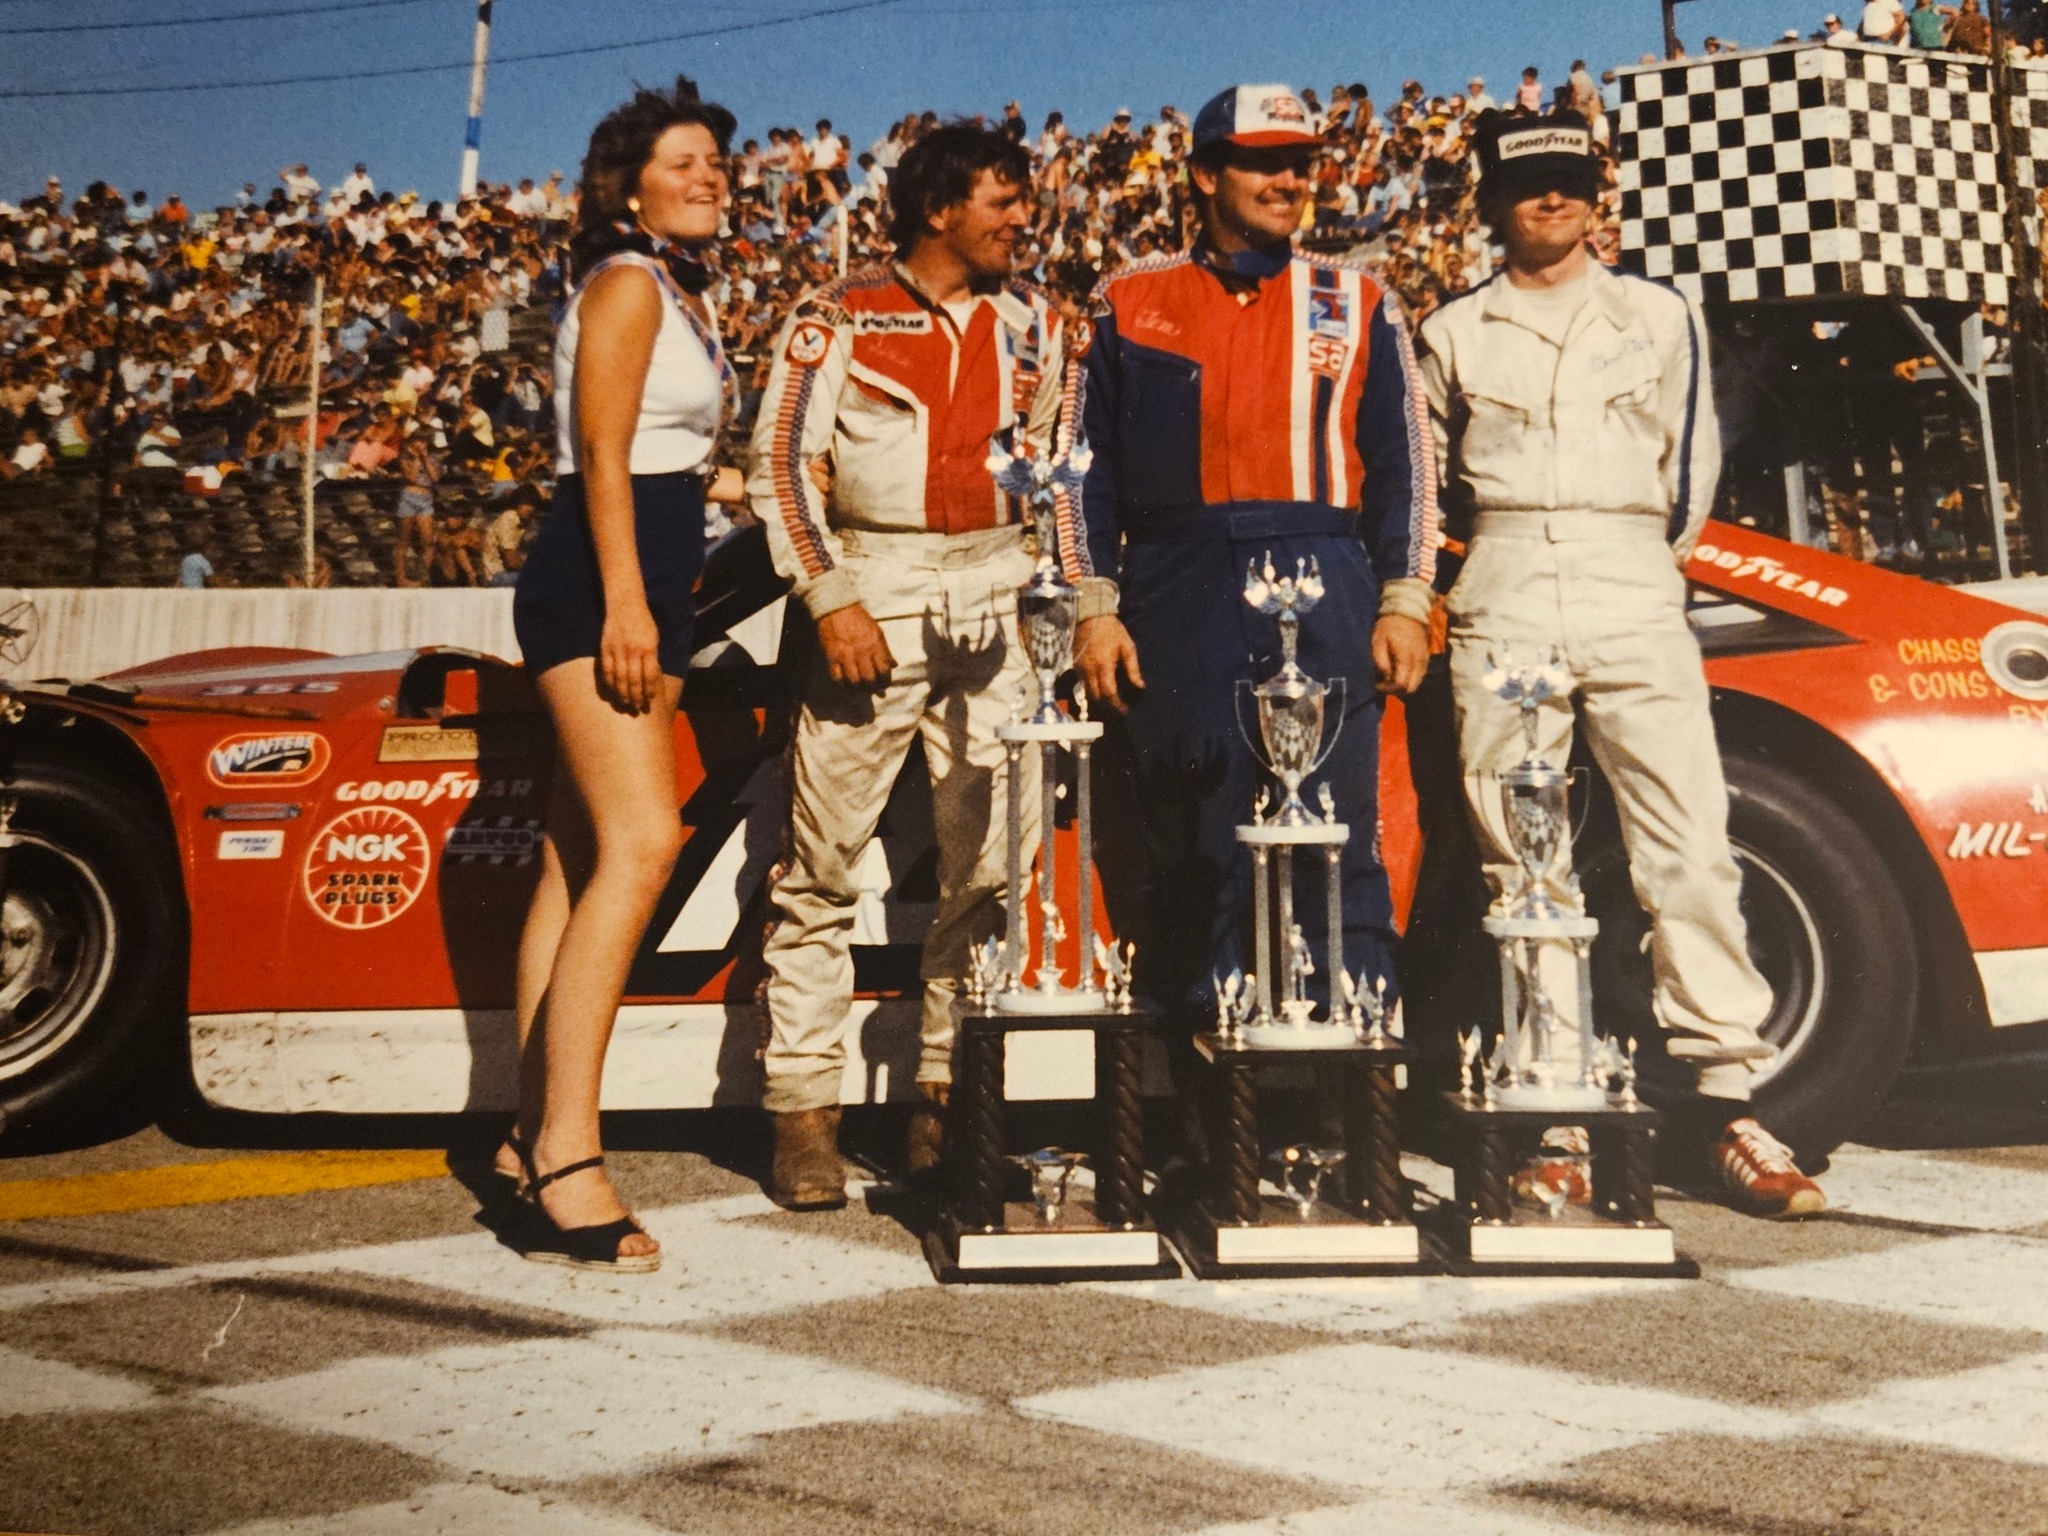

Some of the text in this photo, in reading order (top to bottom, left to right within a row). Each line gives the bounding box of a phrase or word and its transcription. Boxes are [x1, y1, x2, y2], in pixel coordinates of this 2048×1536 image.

[1505, 132, 1583, 153] GOODYEAR
[1869, 673, 1898, 703] &
[327, 833, 410, 863] NGK
[327, 873, 401, 887] SPARK
[325, 891, 400, 905] PLUGS
